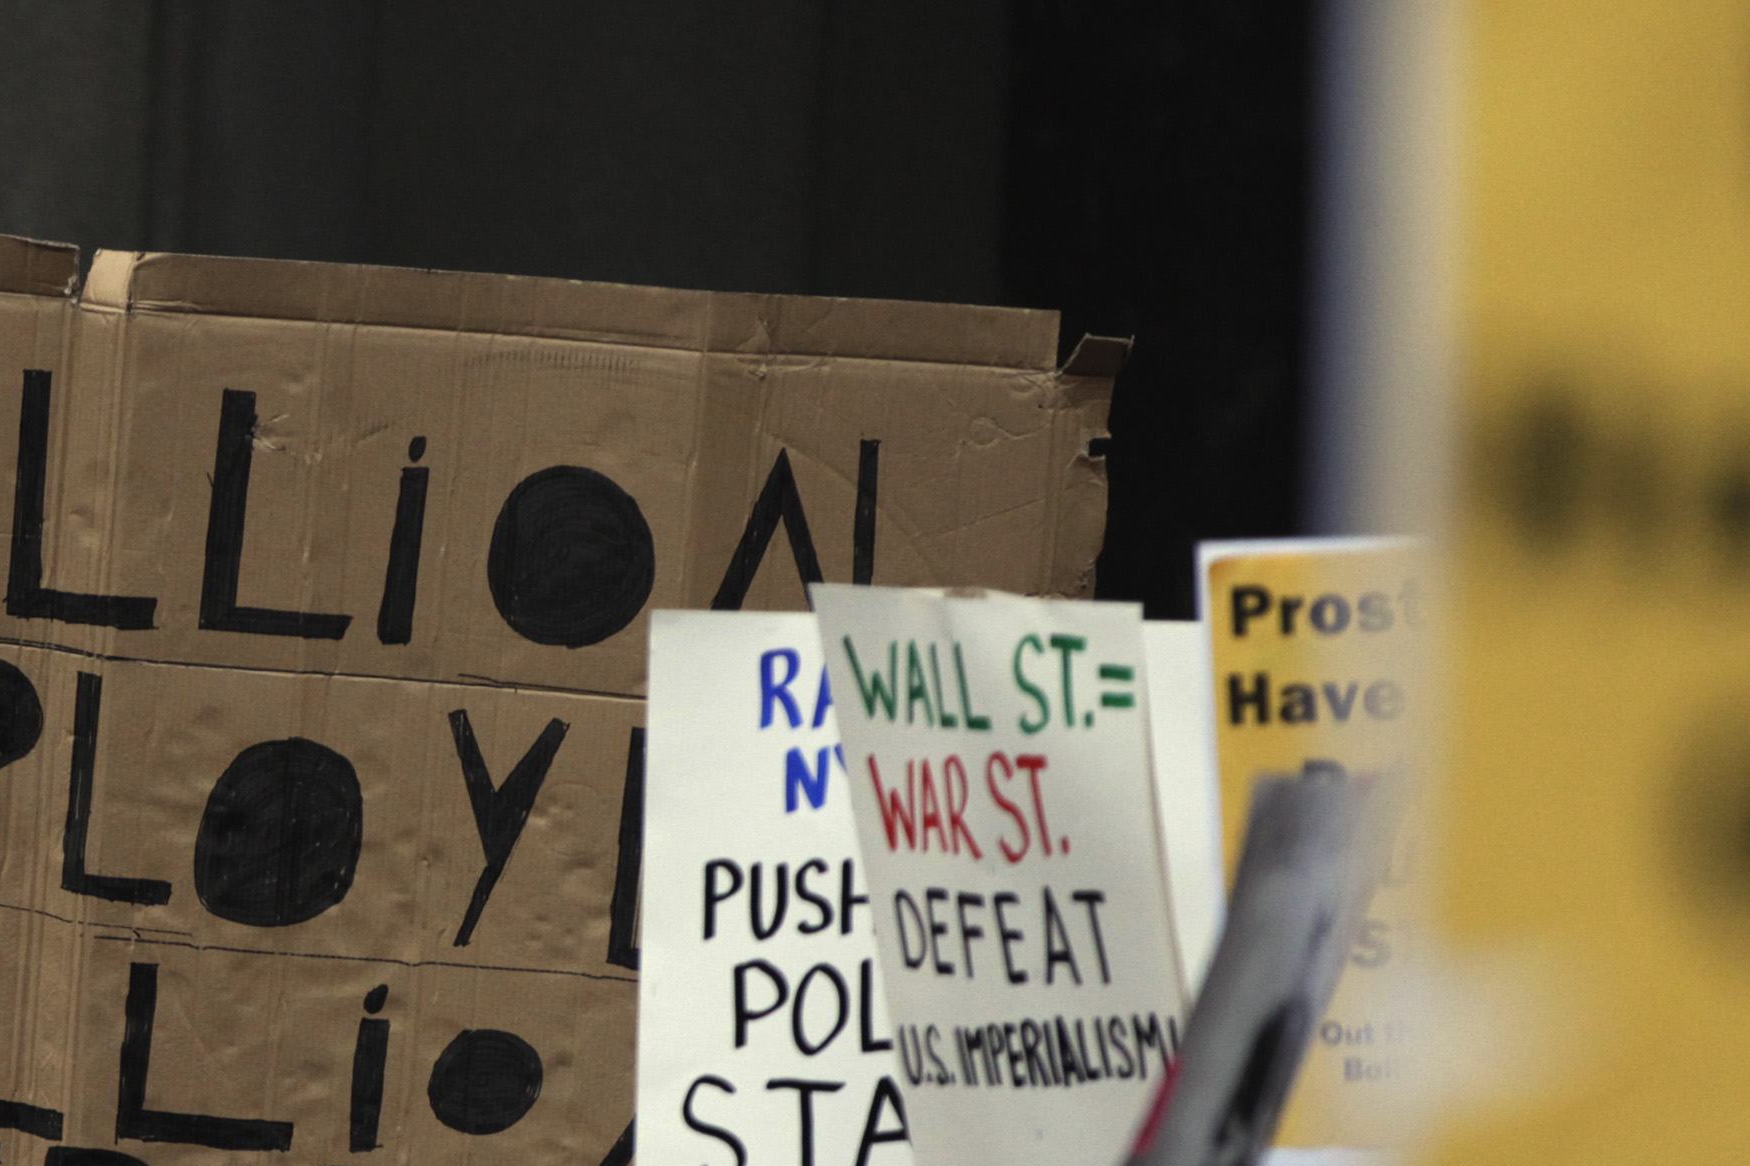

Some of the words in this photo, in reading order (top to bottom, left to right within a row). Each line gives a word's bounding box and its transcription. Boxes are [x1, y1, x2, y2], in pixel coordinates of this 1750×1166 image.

[843, 634, 992, 731] WALL
[1223, 668, 1402, 729] Have
[786, 743, 847, 814] N
[867, 752, 983, 860] WAR
[986, 751, 1071, 863] ST.
[704, 857, 870, 940] PUSH
[894, 886, 1111, 986] DEFEAT
[733, 958, 892, 1056] POL
[898, 1023, 956, 1086] U.S.
